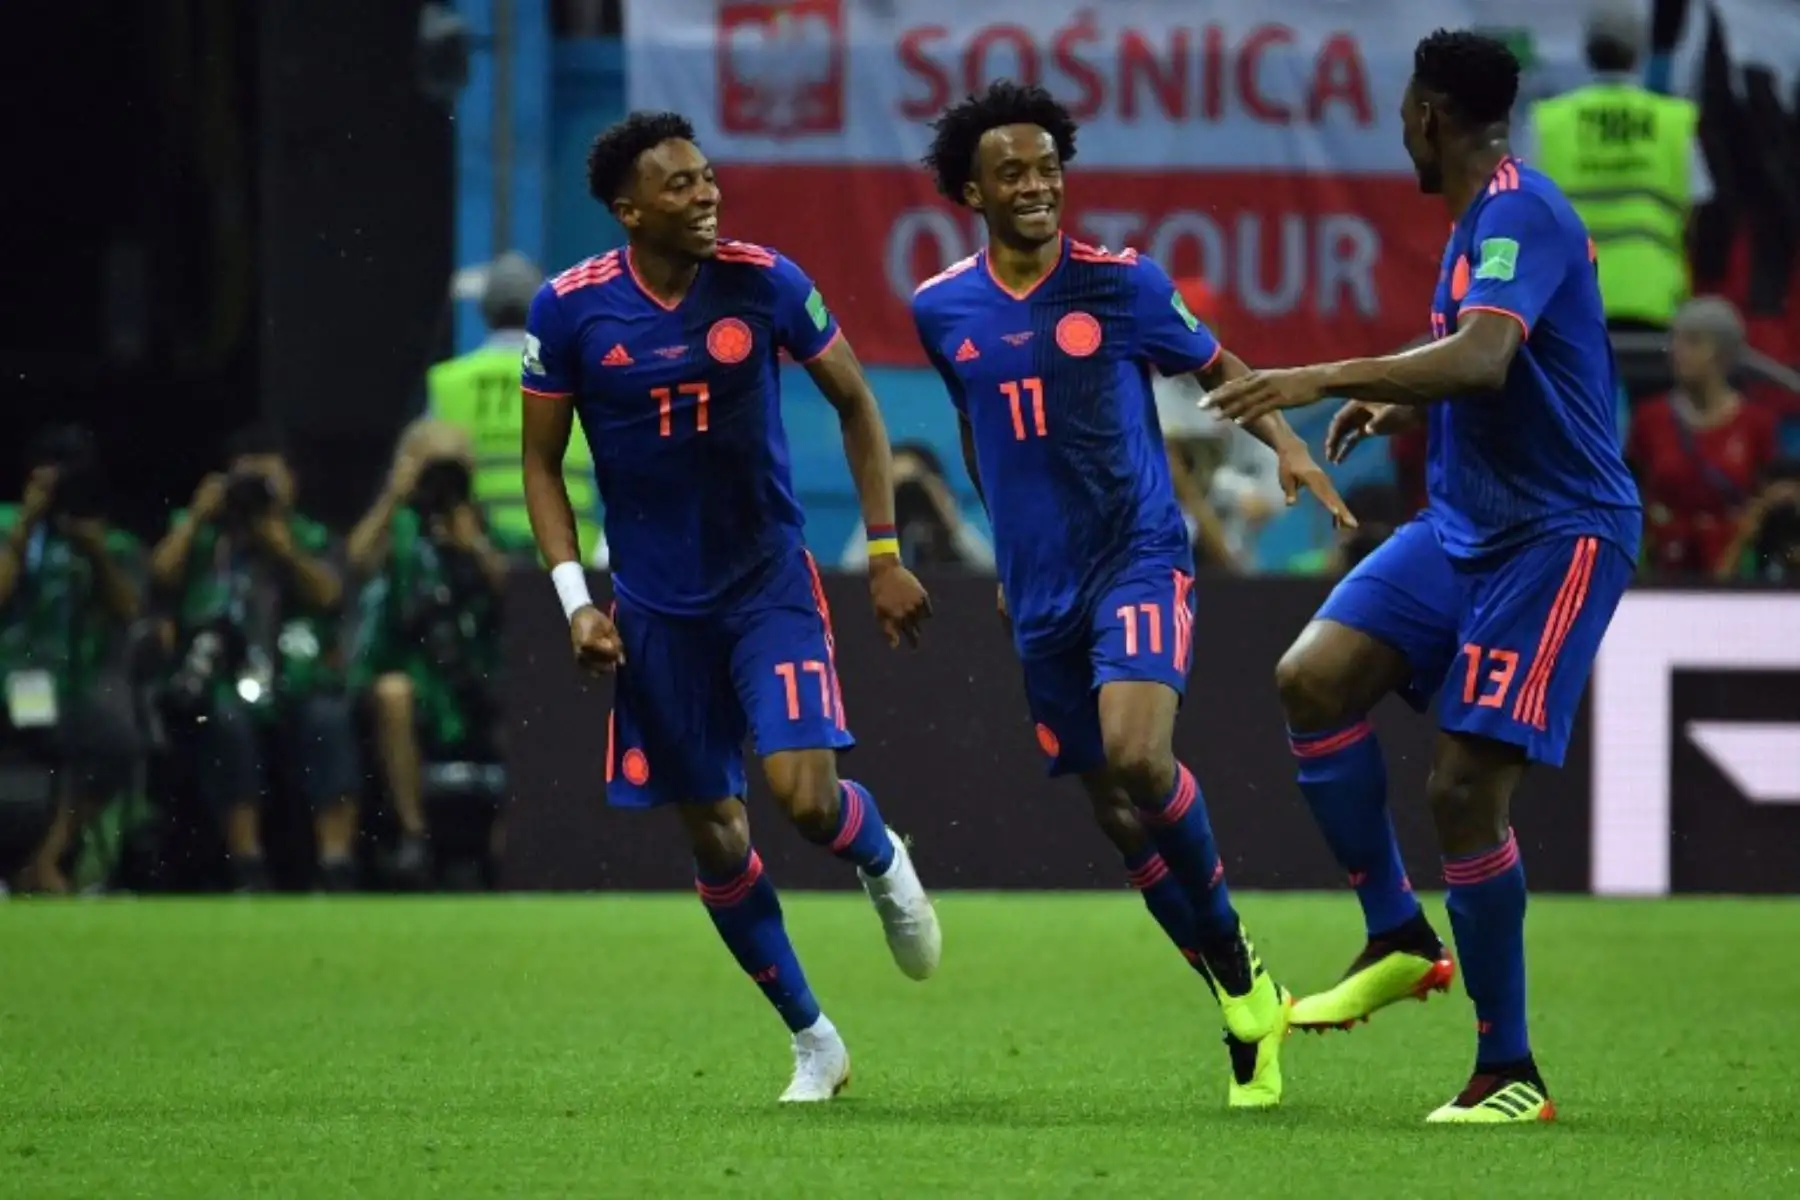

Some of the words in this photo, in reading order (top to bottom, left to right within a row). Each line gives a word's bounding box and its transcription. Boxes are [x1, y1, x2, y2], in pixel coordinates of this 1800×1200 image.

[896, 5, 1377, 128] SOŚNICA
[887, 206, 990, 305] O
[1078, 208, 1382, 318] TOUR
[650, 382, 710, 437] 17
[999, 376, 1048, 441] 11
[1116, 603, 1163, 656] 11
[774, 660, 832, 720] 17
[1462, 642, 1520, 709] 13
